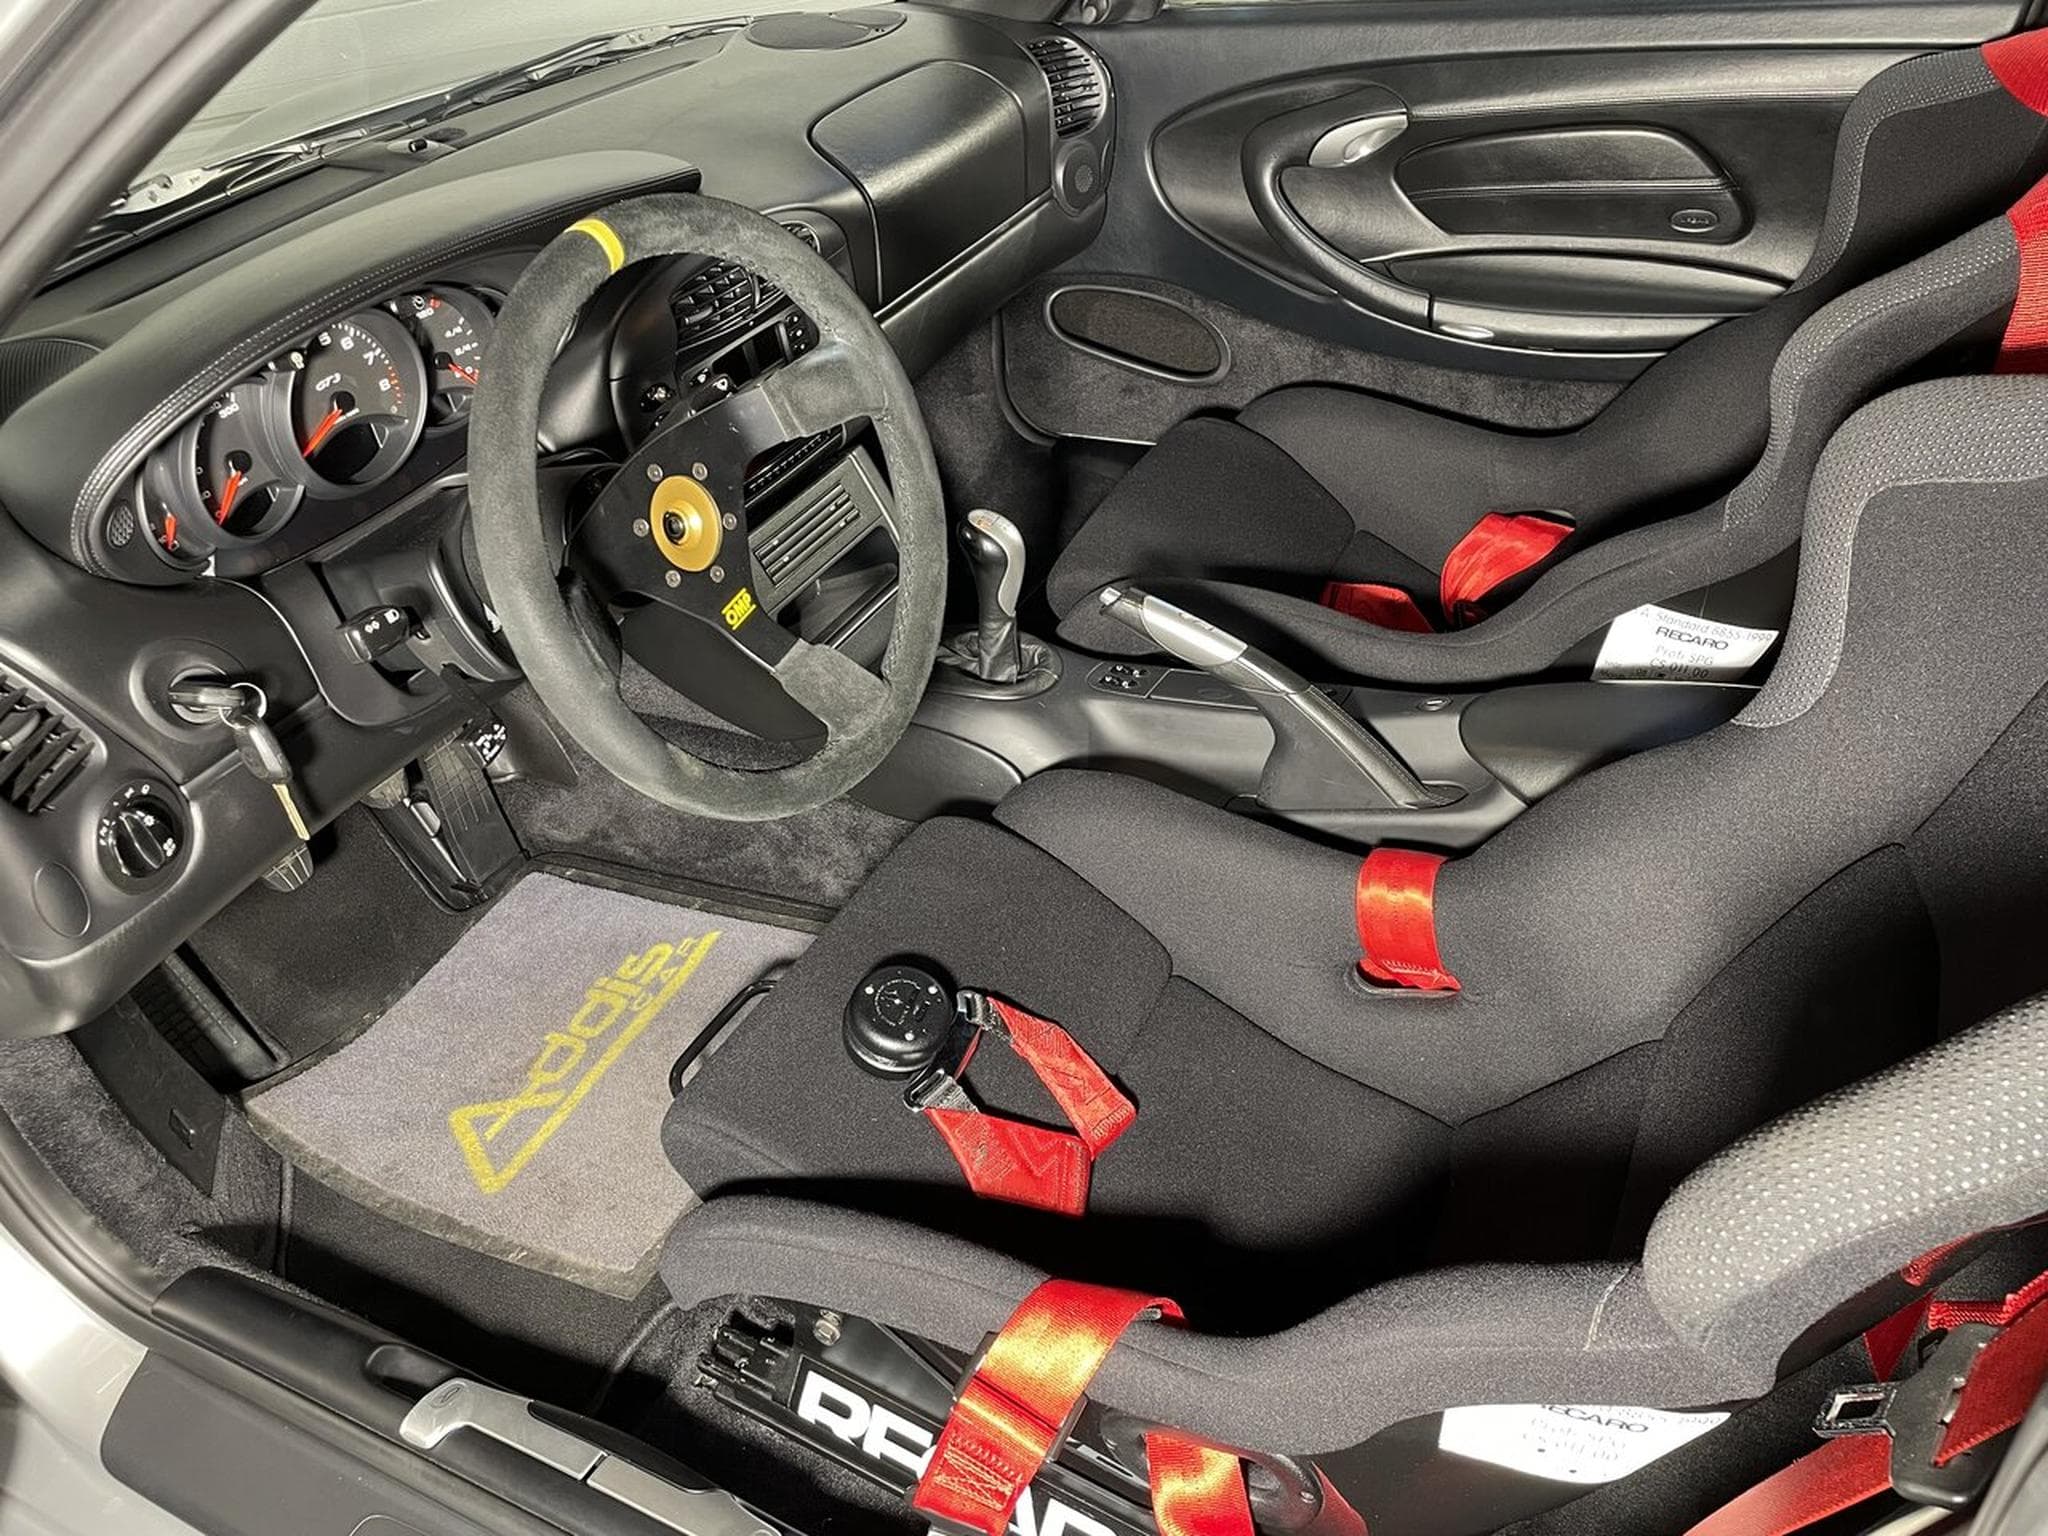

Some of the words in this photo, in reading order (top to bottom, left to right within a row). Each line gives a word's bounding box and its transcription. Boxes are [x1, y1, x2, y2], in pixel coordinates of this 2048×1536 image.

[318, 332, 332, 346] 5
[340, 336, 354, 351] 6
[363, 351, 375, 366] 7
[315, 372, 341, 392] GT3
[379, 378, 391, 392] 8
[723, 589, 754, 628] OMP
[1656, 626, 1729, 650] RECARO
[1541, 1404, 1649, 1432] ECARO
